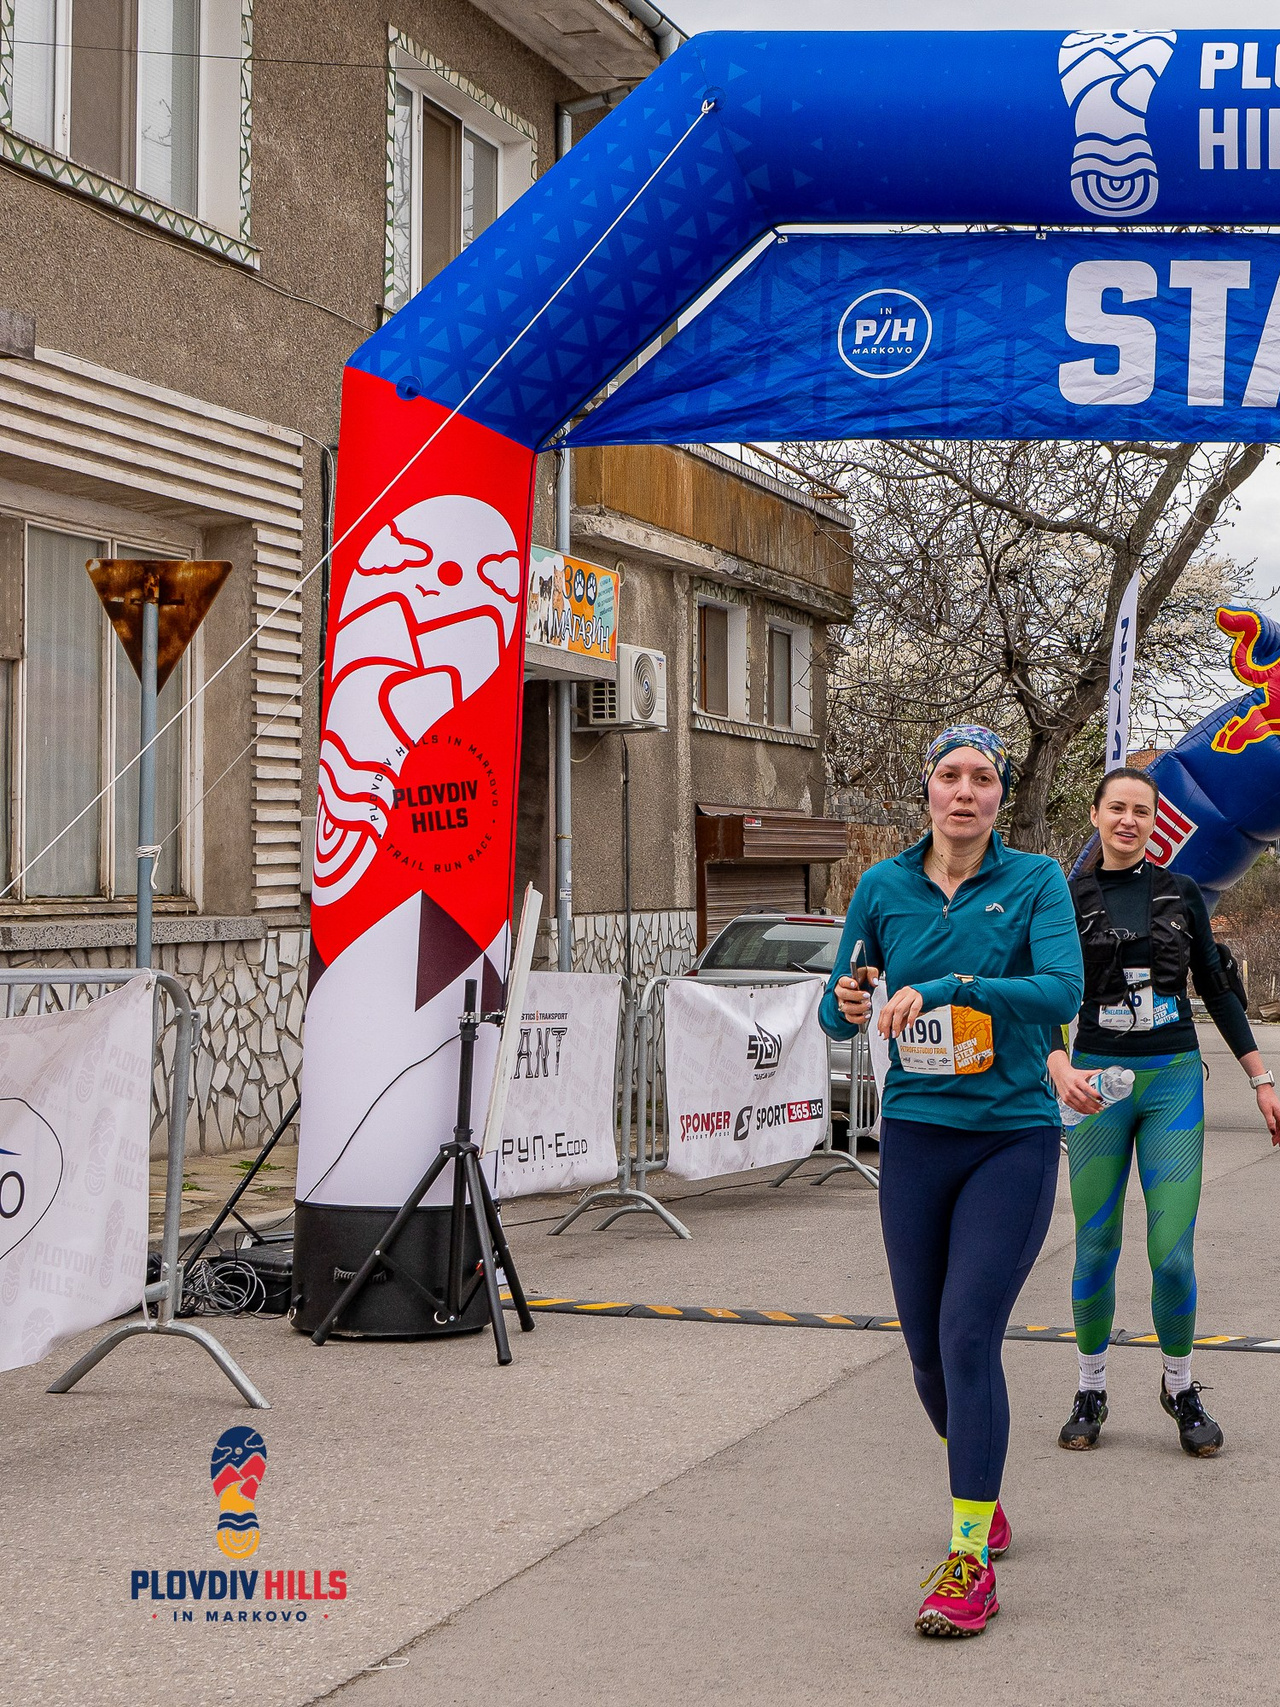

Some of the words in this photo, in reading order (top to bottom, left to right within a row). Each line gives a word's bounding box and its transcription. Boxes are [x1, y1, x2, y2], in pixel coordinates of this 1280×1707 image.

[880, 307, 892, 315] IN
[854, 318, 916, 345] P/H
[852, 346, 912, 355] MARKOVO
[553, 608, 610, 654] МАГАЗИН
[448, 735, 462, 746] IN
[392, 779, 478, 810] PLOVDIV
[411, 808, 469, 834] HILLS
[386, 843, 424, 871] TRAIL
[434, 862, 462, 873] RUN
[467, 832, 492, 863] RACE
[539, 1012, 568, 1020] TRANSPORT
[679, 1110, 731, 1143] SPONSER
